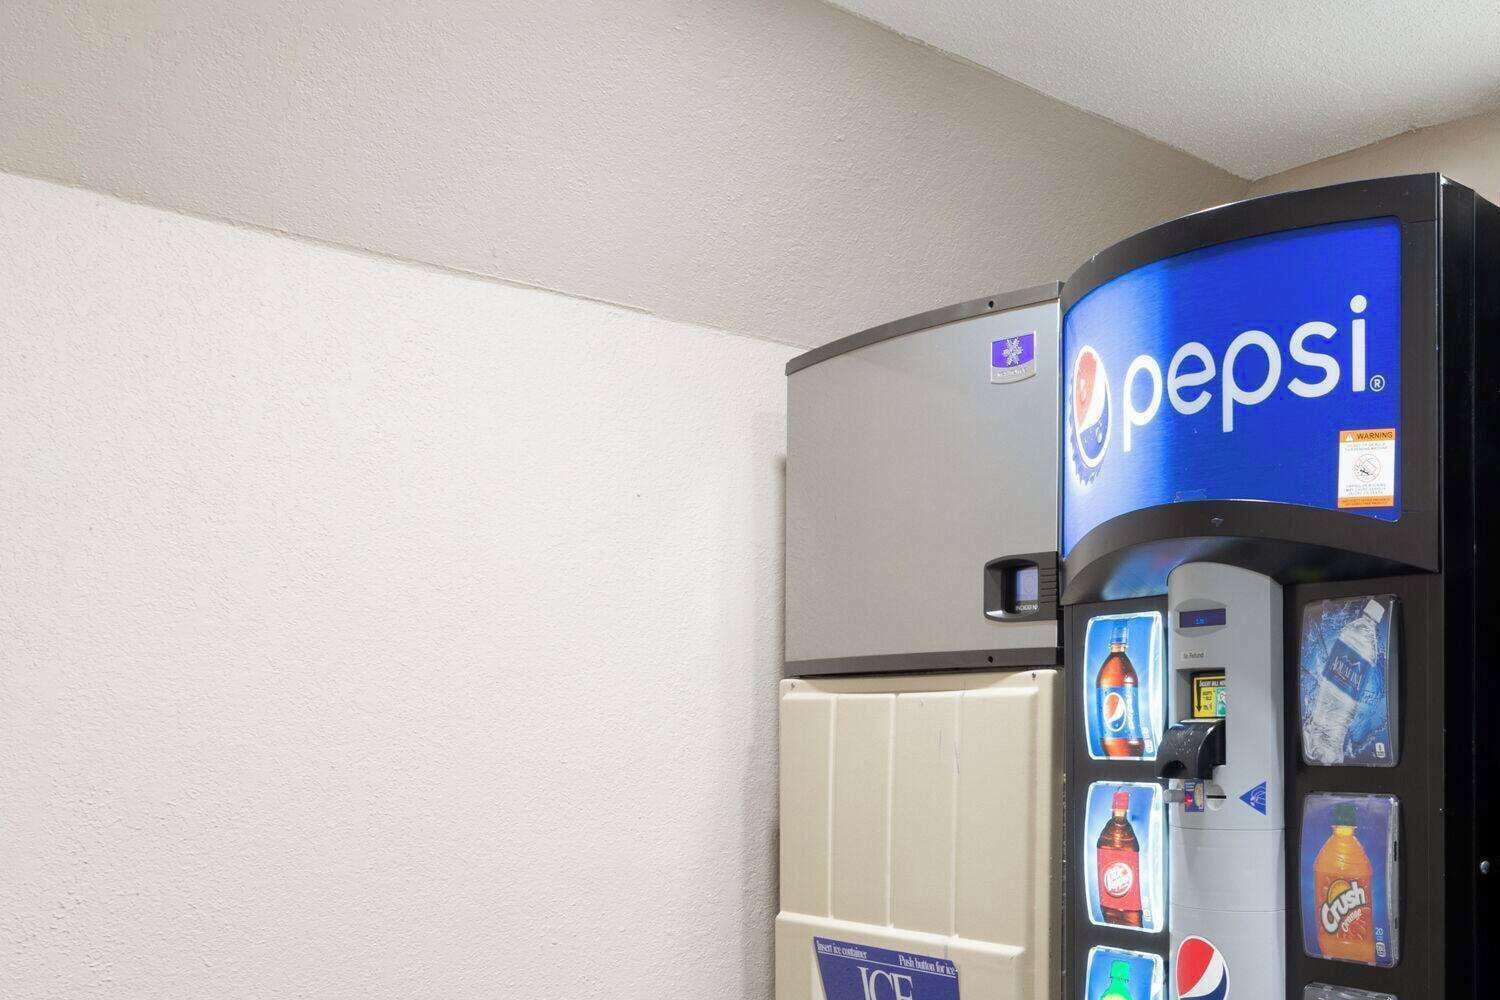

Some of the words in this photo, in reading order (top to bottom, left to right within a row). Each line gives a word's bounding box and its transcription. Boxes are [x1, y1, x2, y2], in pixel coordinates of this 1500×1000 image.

[1123, 294, 1367, 452] pepsi
[1357, 432, 1393, 440] WARNING
[1321, 881, 1366, 934] Crush
[898, 955, 915, 967] Push
[915, 957, 935, 972] button
[935, 961, 945, 973] for
